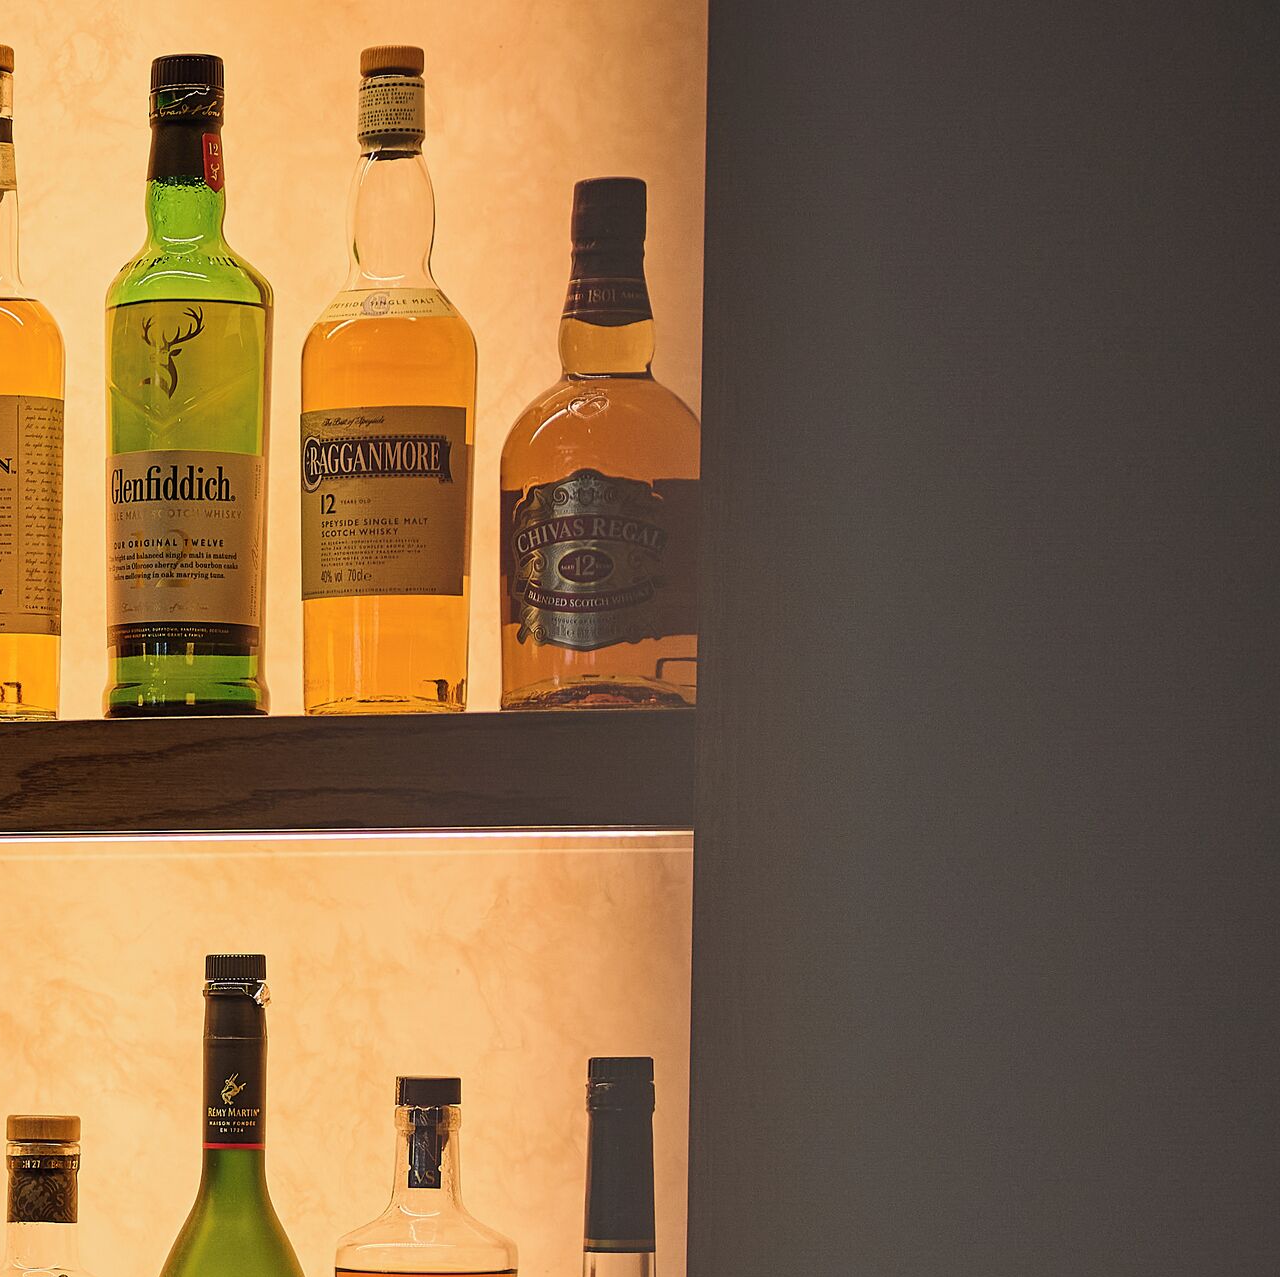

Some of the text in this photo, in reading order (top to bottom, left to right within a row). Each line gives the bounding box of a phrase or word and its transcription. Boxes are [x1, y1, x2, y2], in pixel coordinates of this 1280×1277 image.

[303, 435, 441, 493] CRAGGANMORE
[111, 465, 231, 505] Glenfiddich
[320, 493, 337, 515] 12
[321, 519, 359, 528] SPEYSIDE
[321, 527, 399, 538] SCOTCH WHISKY
[517, 517, 660, 553] CHIVAS REGAL
[207, 1106, 258, 1117] RÉMY MARTIN
